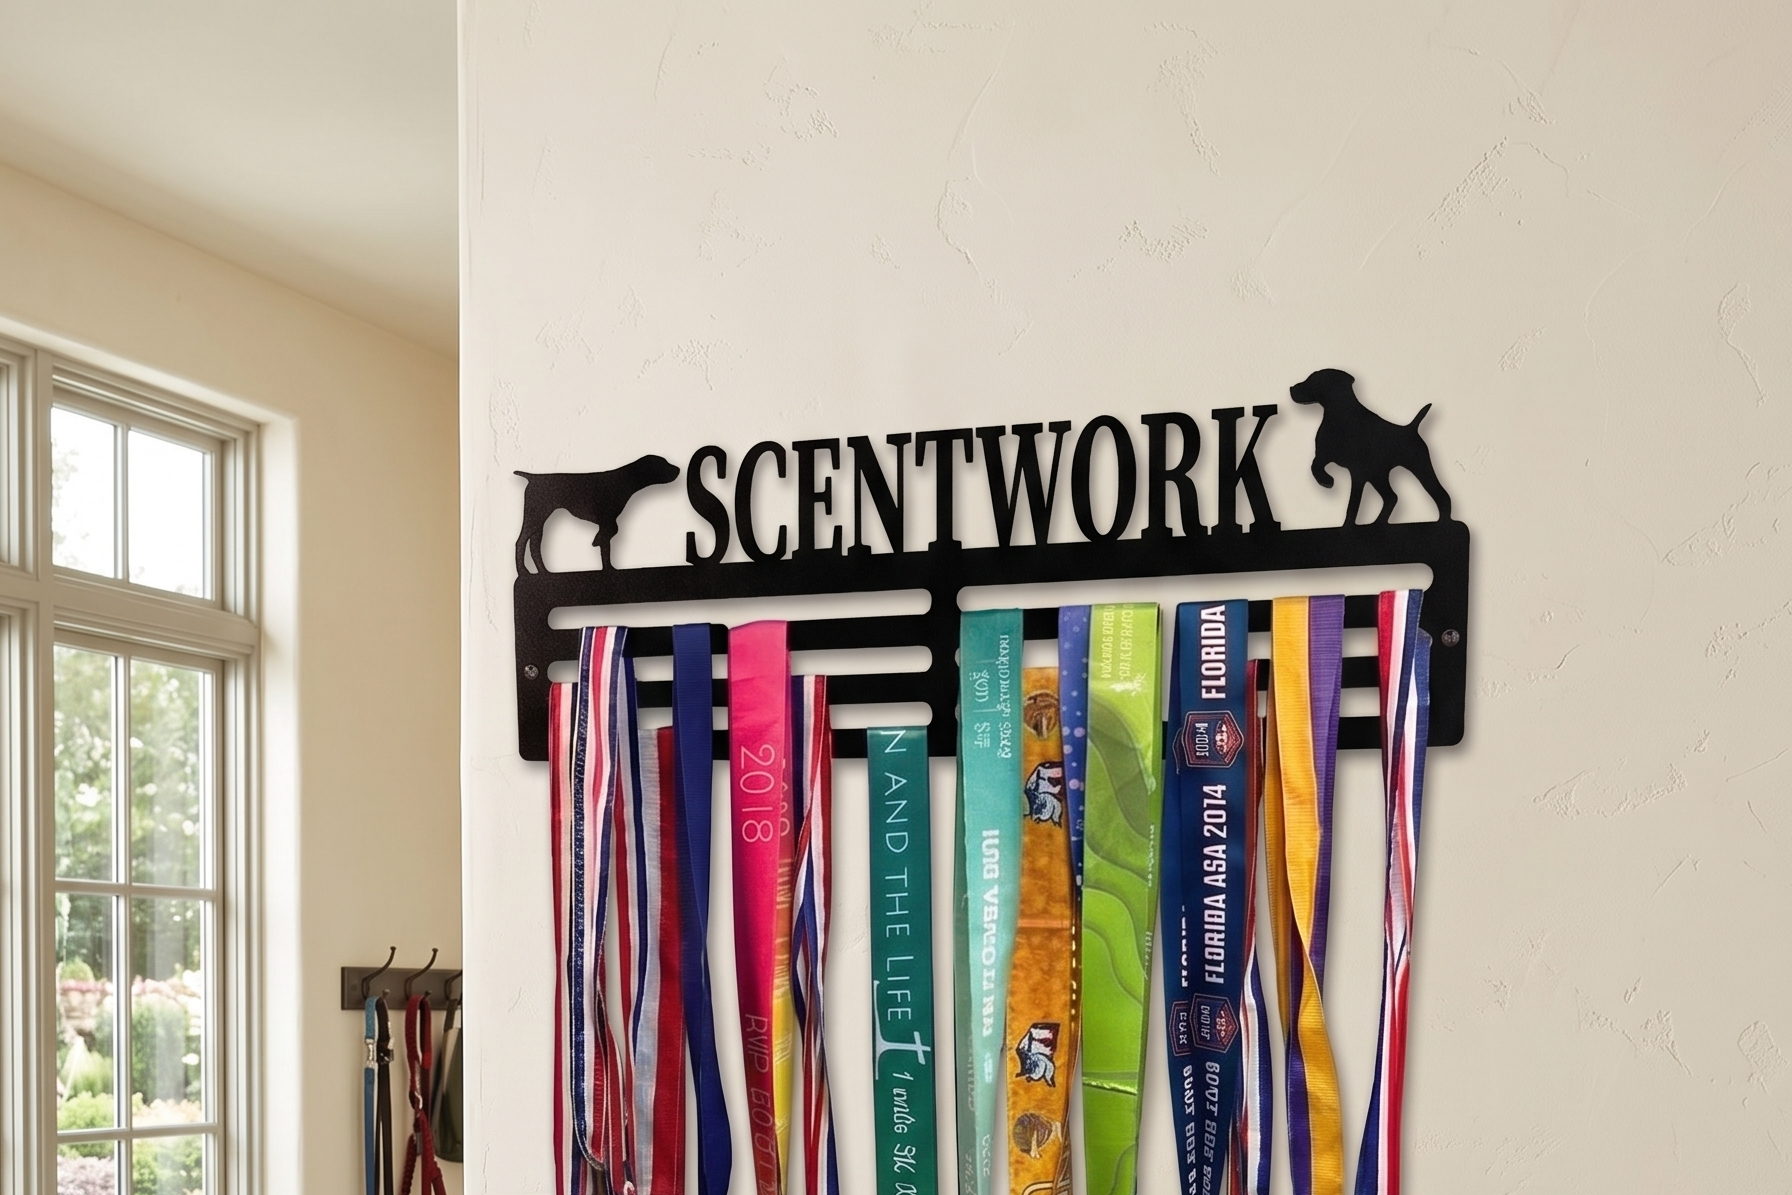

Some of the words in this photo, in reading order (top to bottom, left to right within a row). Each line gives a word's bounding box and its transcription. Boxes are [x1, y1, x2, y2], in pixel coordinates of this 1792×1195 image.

[686, 404, 1281, 565] SCENTWORK
[1201, 605, 1226, 699] FLORIDA
[740, 744, 775, 842] 2018
[885, 772, 909, 853] AND
[1203, 784, 1227, 839] 2014
[885, 867, 910, 937] THE
[1203, 845, 1227, 887] ASA
[887, 956, 914, 1021] LIFE
